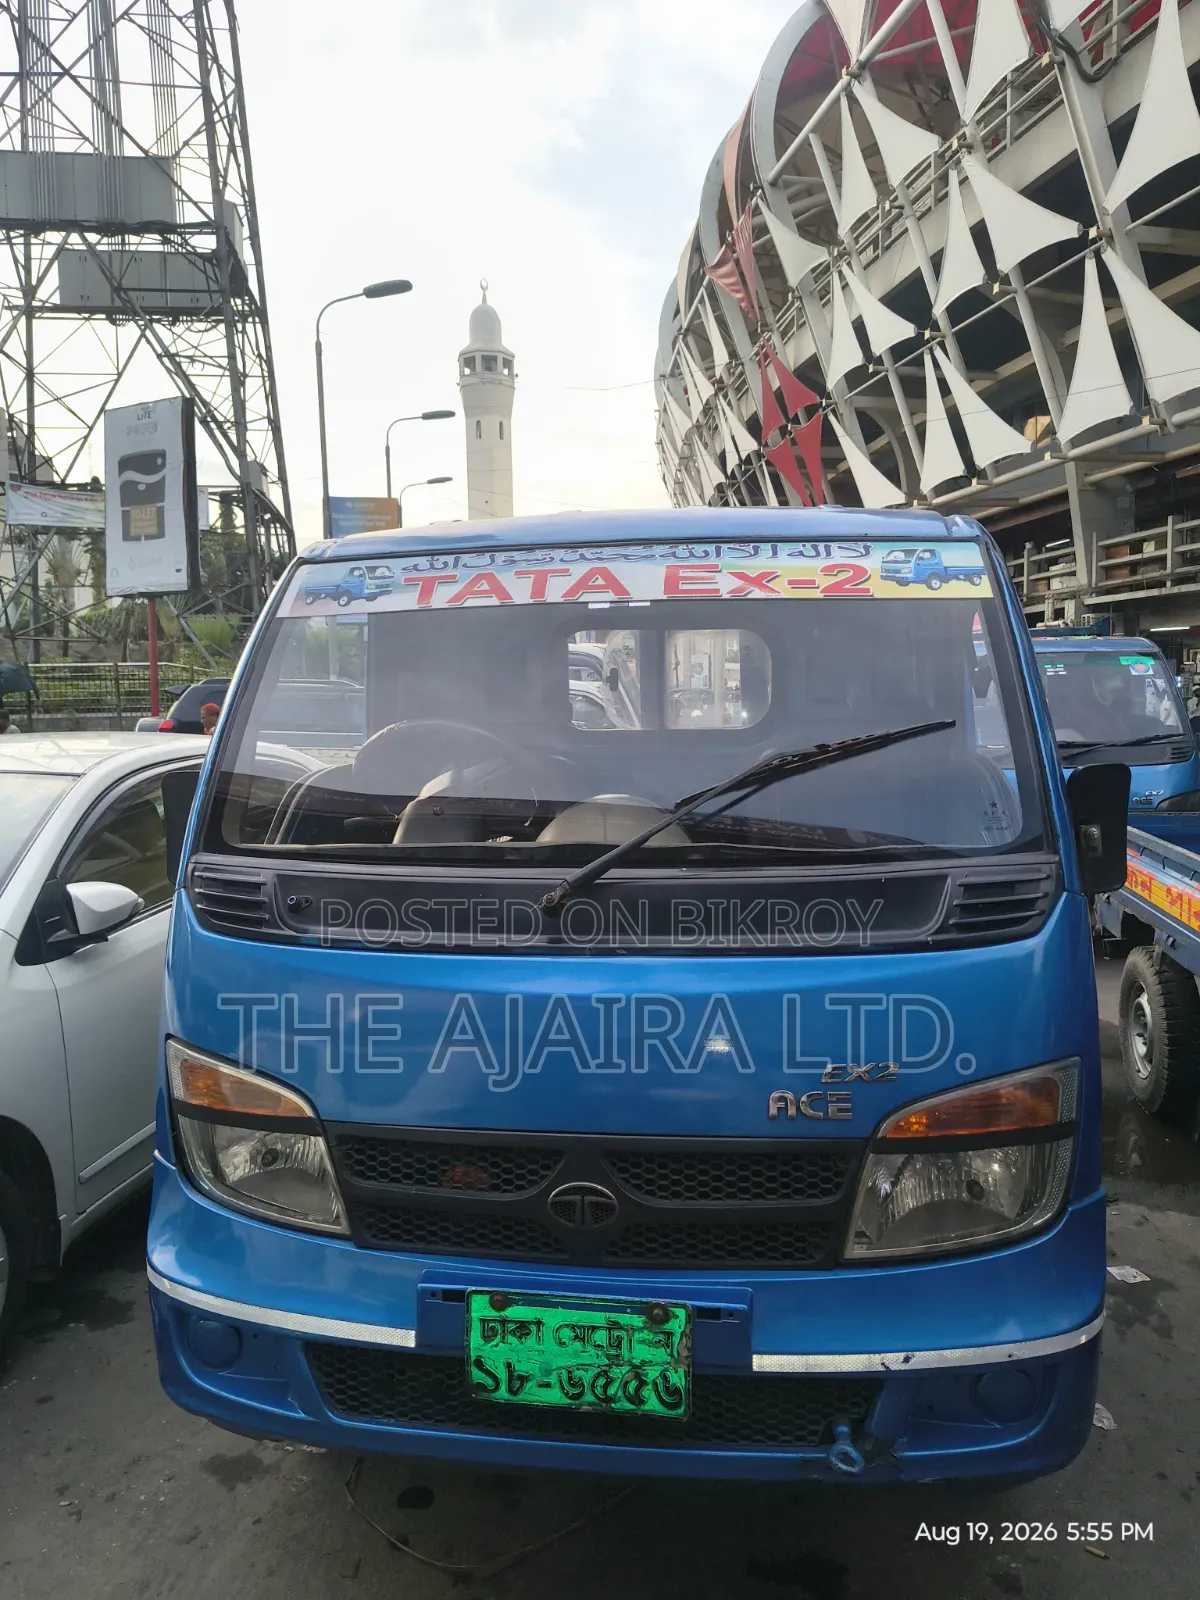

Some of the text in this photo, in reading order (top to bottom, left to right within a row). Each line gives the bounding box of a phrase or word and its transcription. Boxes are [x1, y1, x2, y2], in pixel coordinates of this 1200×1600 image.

[402, 567, 633, 609] TATA
[821, 1063, 899, 1083] EX2
[768, 1090, 852, 1119] ACE
[479, 1316, 545, 1345] ঢাকা
